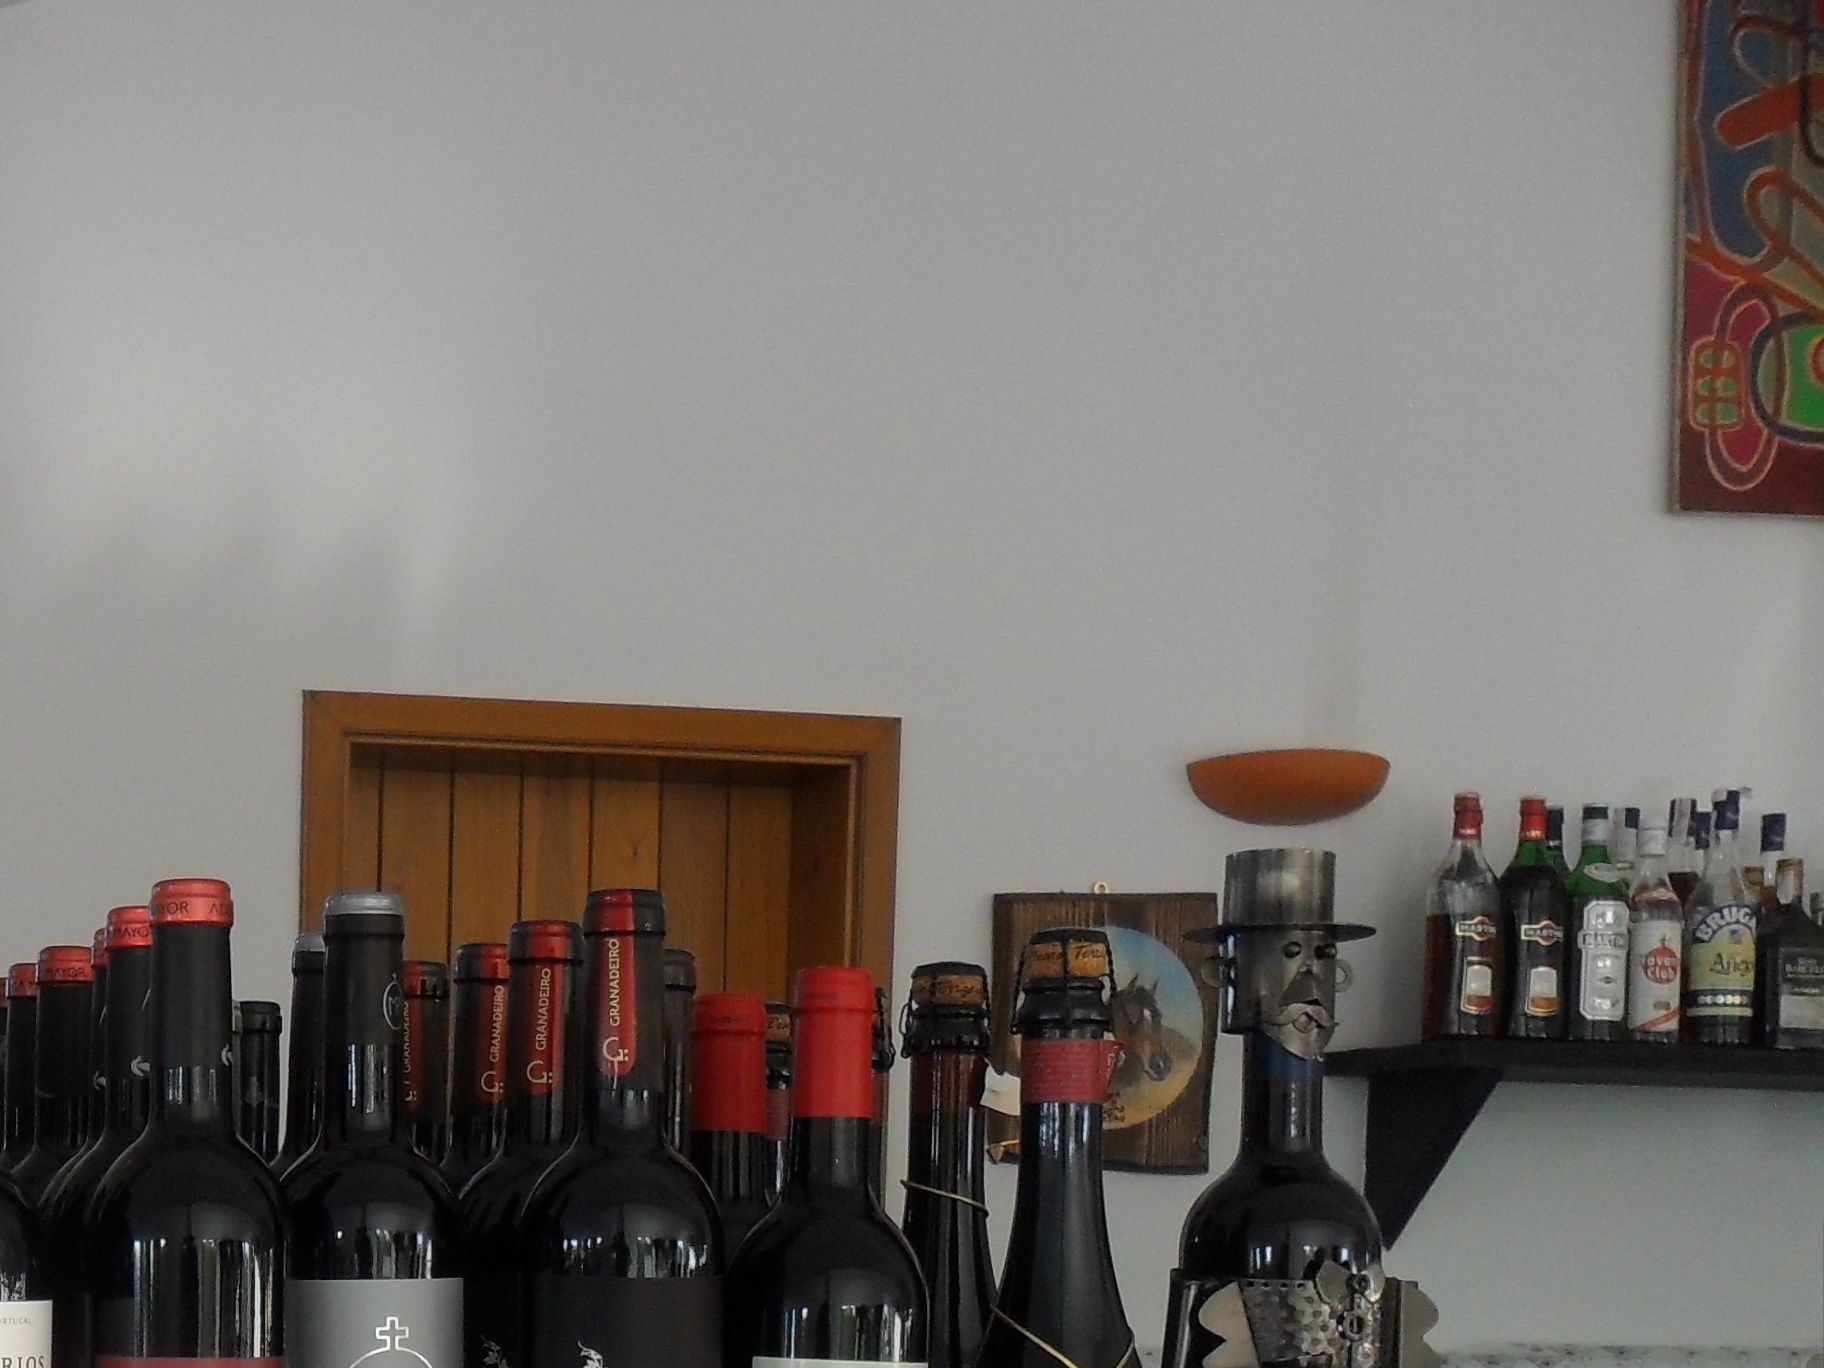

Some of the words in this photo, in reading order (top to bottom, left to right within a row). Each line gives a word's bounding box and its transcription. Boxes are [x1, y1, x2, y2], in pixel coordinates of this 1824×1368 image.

[112, 926, 150, 938] MAYO
[489, 984, 505, 1063] GRANADEIRO
[535, 968, 552, 1051] GRANADEIRO
[608, 939, 621, 1027] GRANADEIRO
